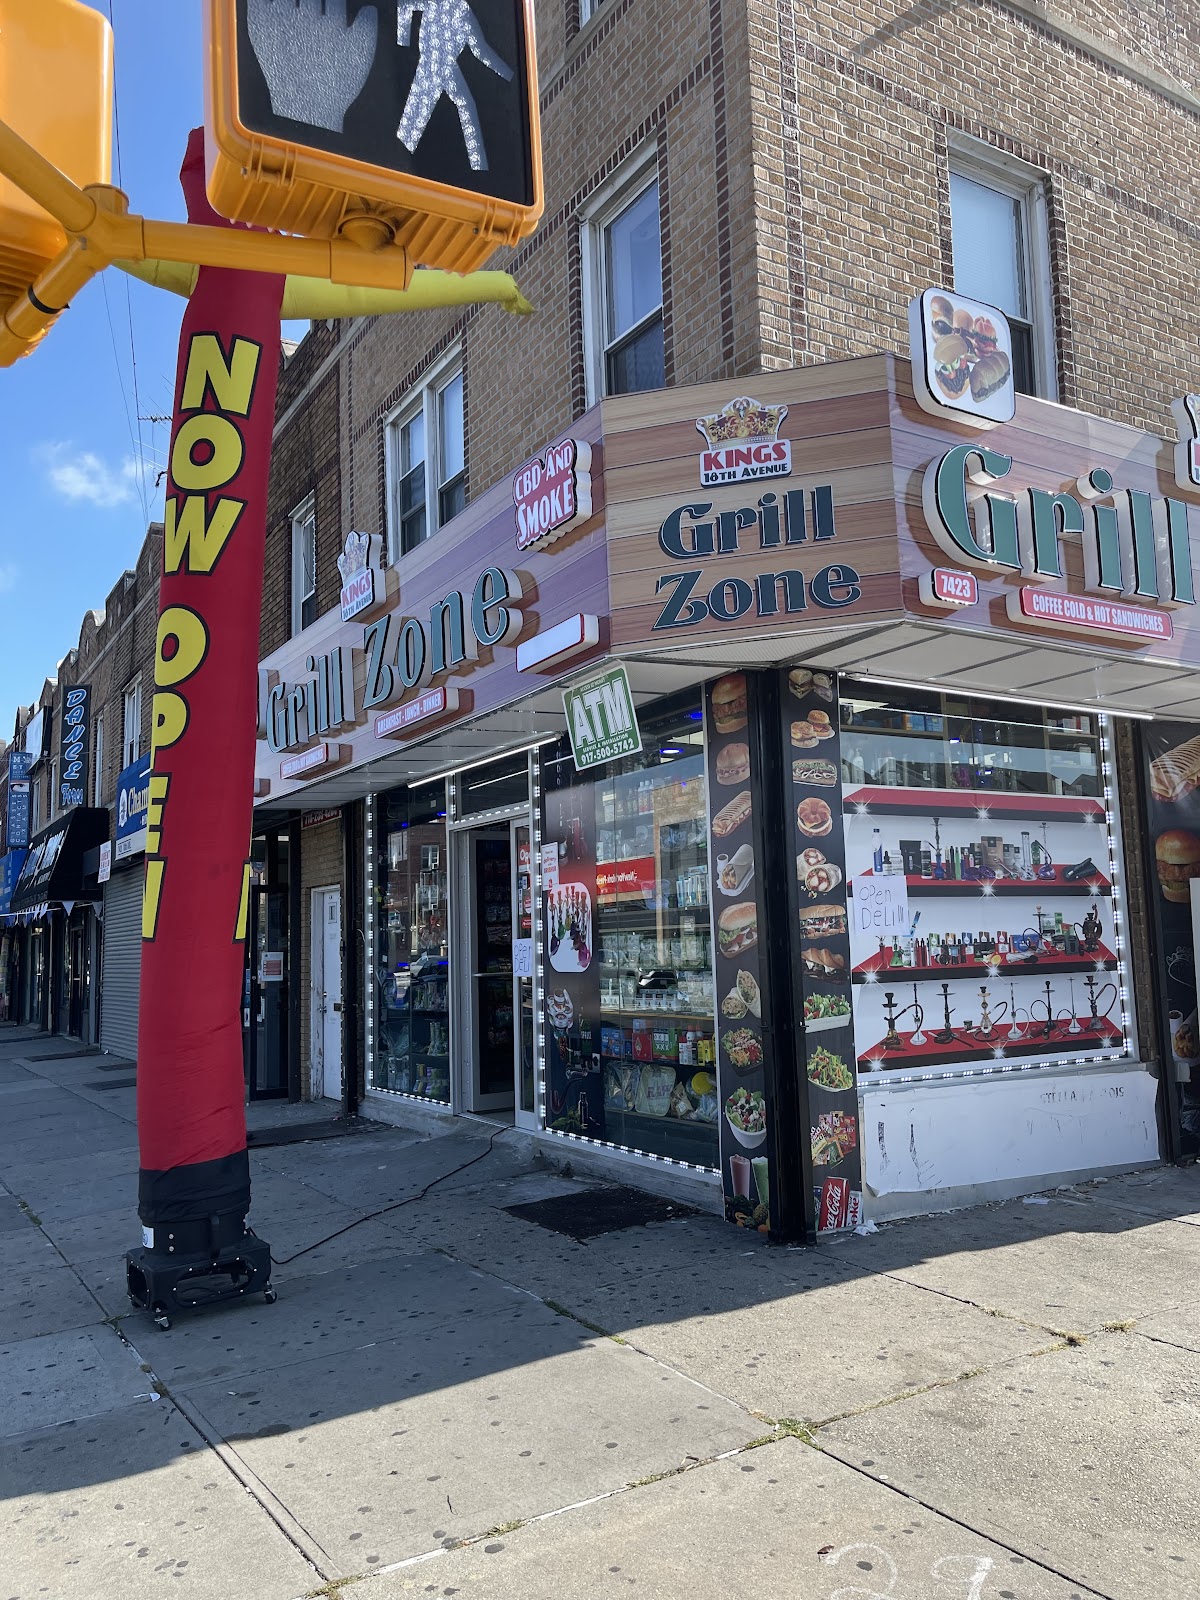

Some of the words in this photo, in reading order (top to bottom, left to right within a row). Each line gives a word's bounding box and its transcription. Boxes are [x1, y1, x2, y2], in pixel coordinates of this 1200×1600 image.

[163, 333, 261, 575] NOW
[515, 464, 541, 500] CBD
[546, 446, 573, 481] AND
[703, 442, 787, 471] KINGS
[704, 471, 737, 483] 18TH
[741, 463, 788, 478] AVENUE
[518, 478, 573, 543] SMOKE
[659, 484, 838, 558] Grill
[934, 443, 1197, 605] Grill
[341, 571, 371, 608] KINGS
[653, 564, 862, 630] Zone
[940, 574, 971, 598] 7423
[1032, 593, 1064, 616] COFFEE
[1064, 600, 1086, 619] COLD
[1086, 606, 1094, 621] &
[1094, 605, 1111, 624] HOT
[1111, 608, 1164, 632] SANDWICHES
[266, 646, 346, 753] Grill
[362, 566, 510, 711] Zone
[62, 688, 87, 780] DANCE
[572, 677, 633, 749] ATM
[128, 786, 149, 817] Cham
